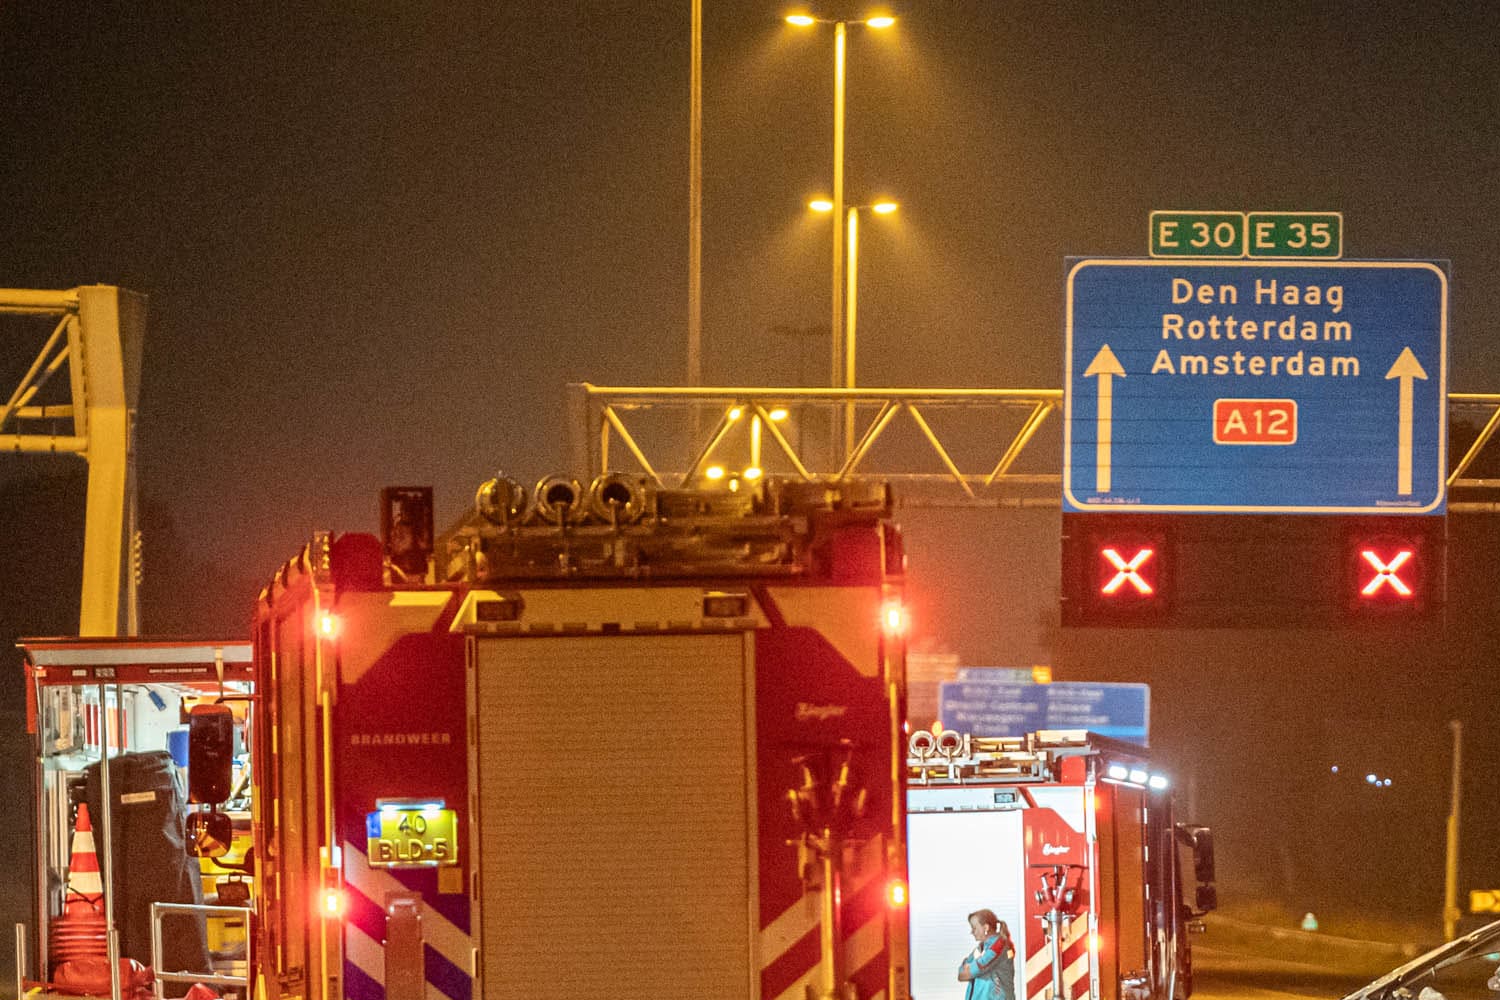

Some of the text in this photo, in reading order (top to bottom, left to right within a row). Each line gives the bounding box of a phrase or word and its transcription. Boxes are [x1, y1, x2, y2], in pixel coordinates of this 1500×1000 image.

[1159, 222, 1237, 248] E 30
[1255, 222, 1332, 249] E 35
[1171, 277, 1345, 314] Den Haag
[1162, 314, 1353, 342] Rotterdam
[1150, 349, 1361, 378] Amsterdam
[1222, 410, 1290, 436] A12
[350, 732, 451, 745] BRANDWEER
[398, 813, 428, 836] 40
[378, 838, 448, 859] BLD-5
